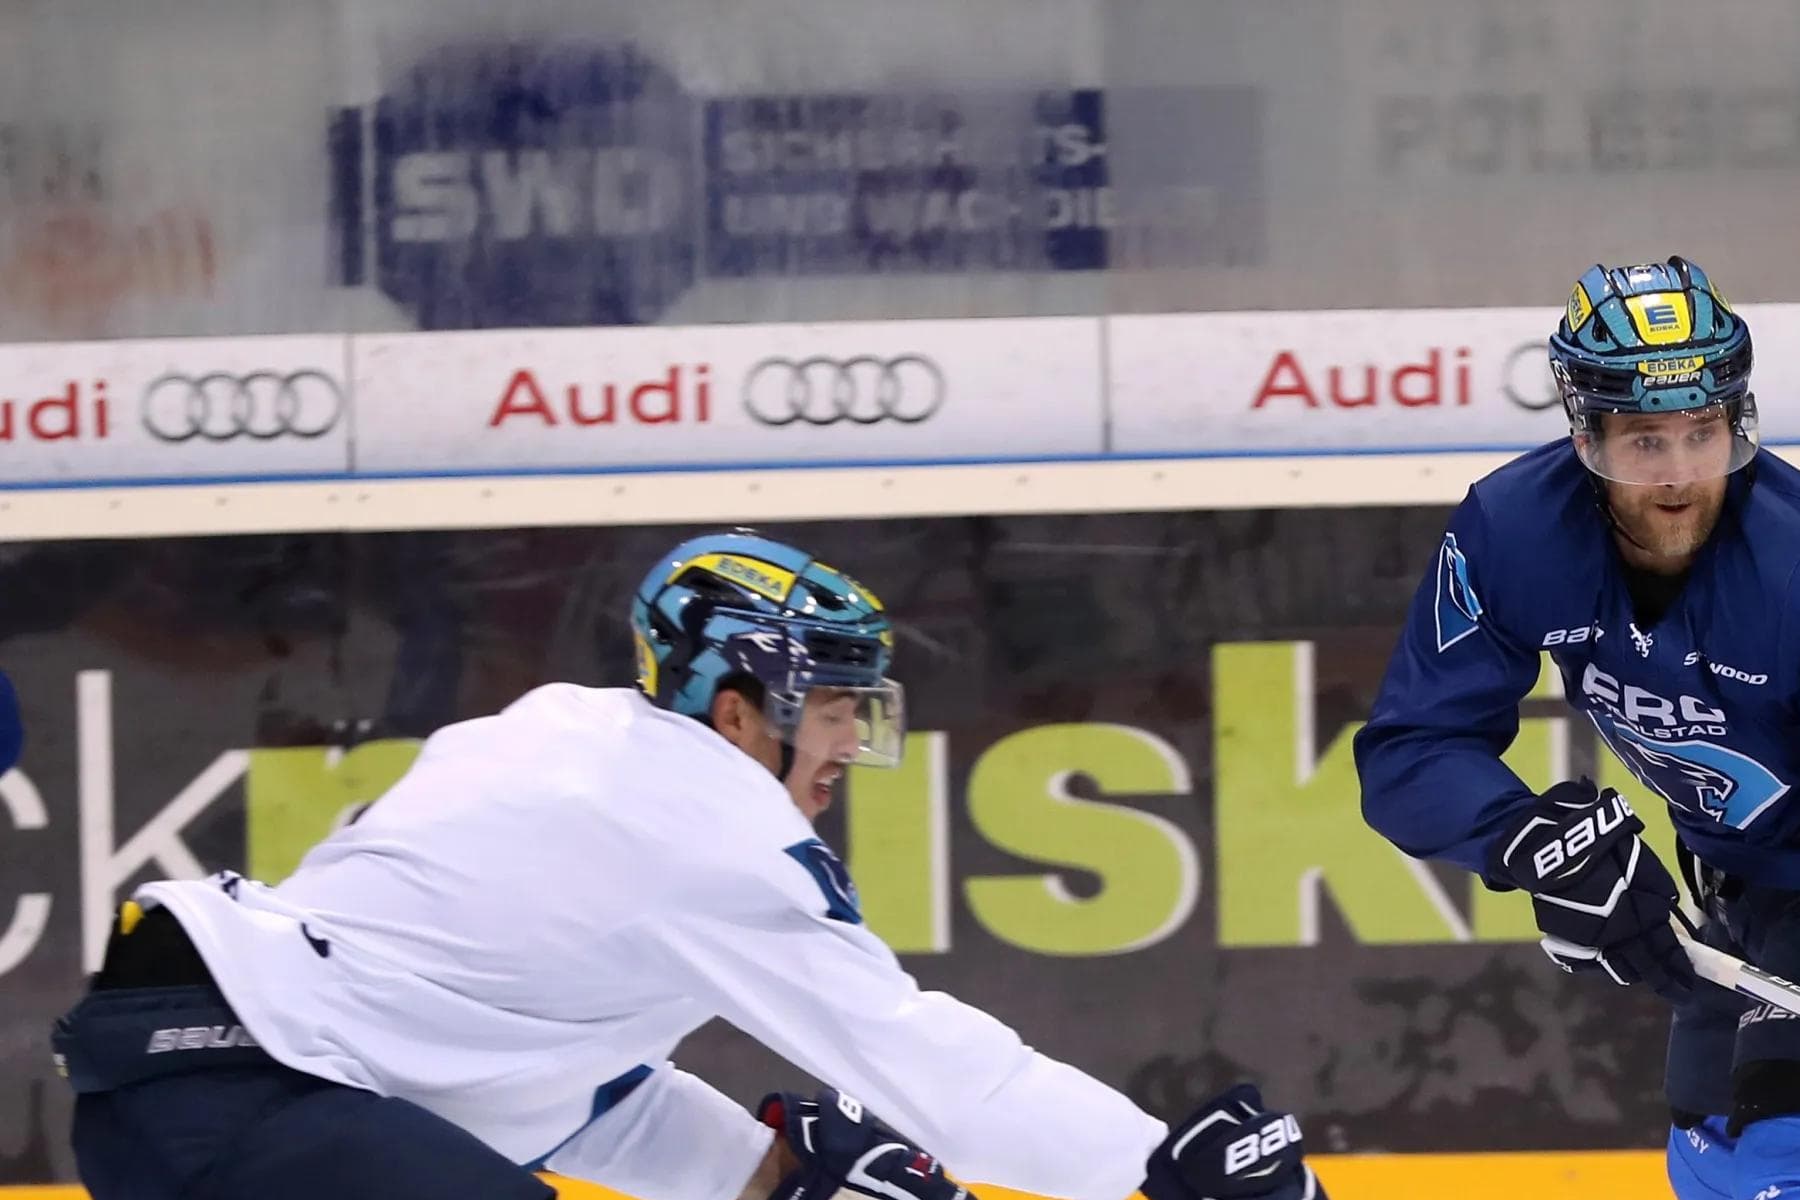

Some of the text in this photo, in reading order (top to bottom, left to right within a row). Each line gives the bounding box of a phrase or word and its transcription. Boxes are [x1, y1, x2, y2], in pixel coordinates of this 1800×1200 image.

[489, 362, 713, 428] Audi
[1251, 347, 1473, 409] Audi
[1647, 360, 1697, 373] EDEKA
[717, 557, 784, 594] EDEKA
[1582, 661, 1727, 726] ERC
